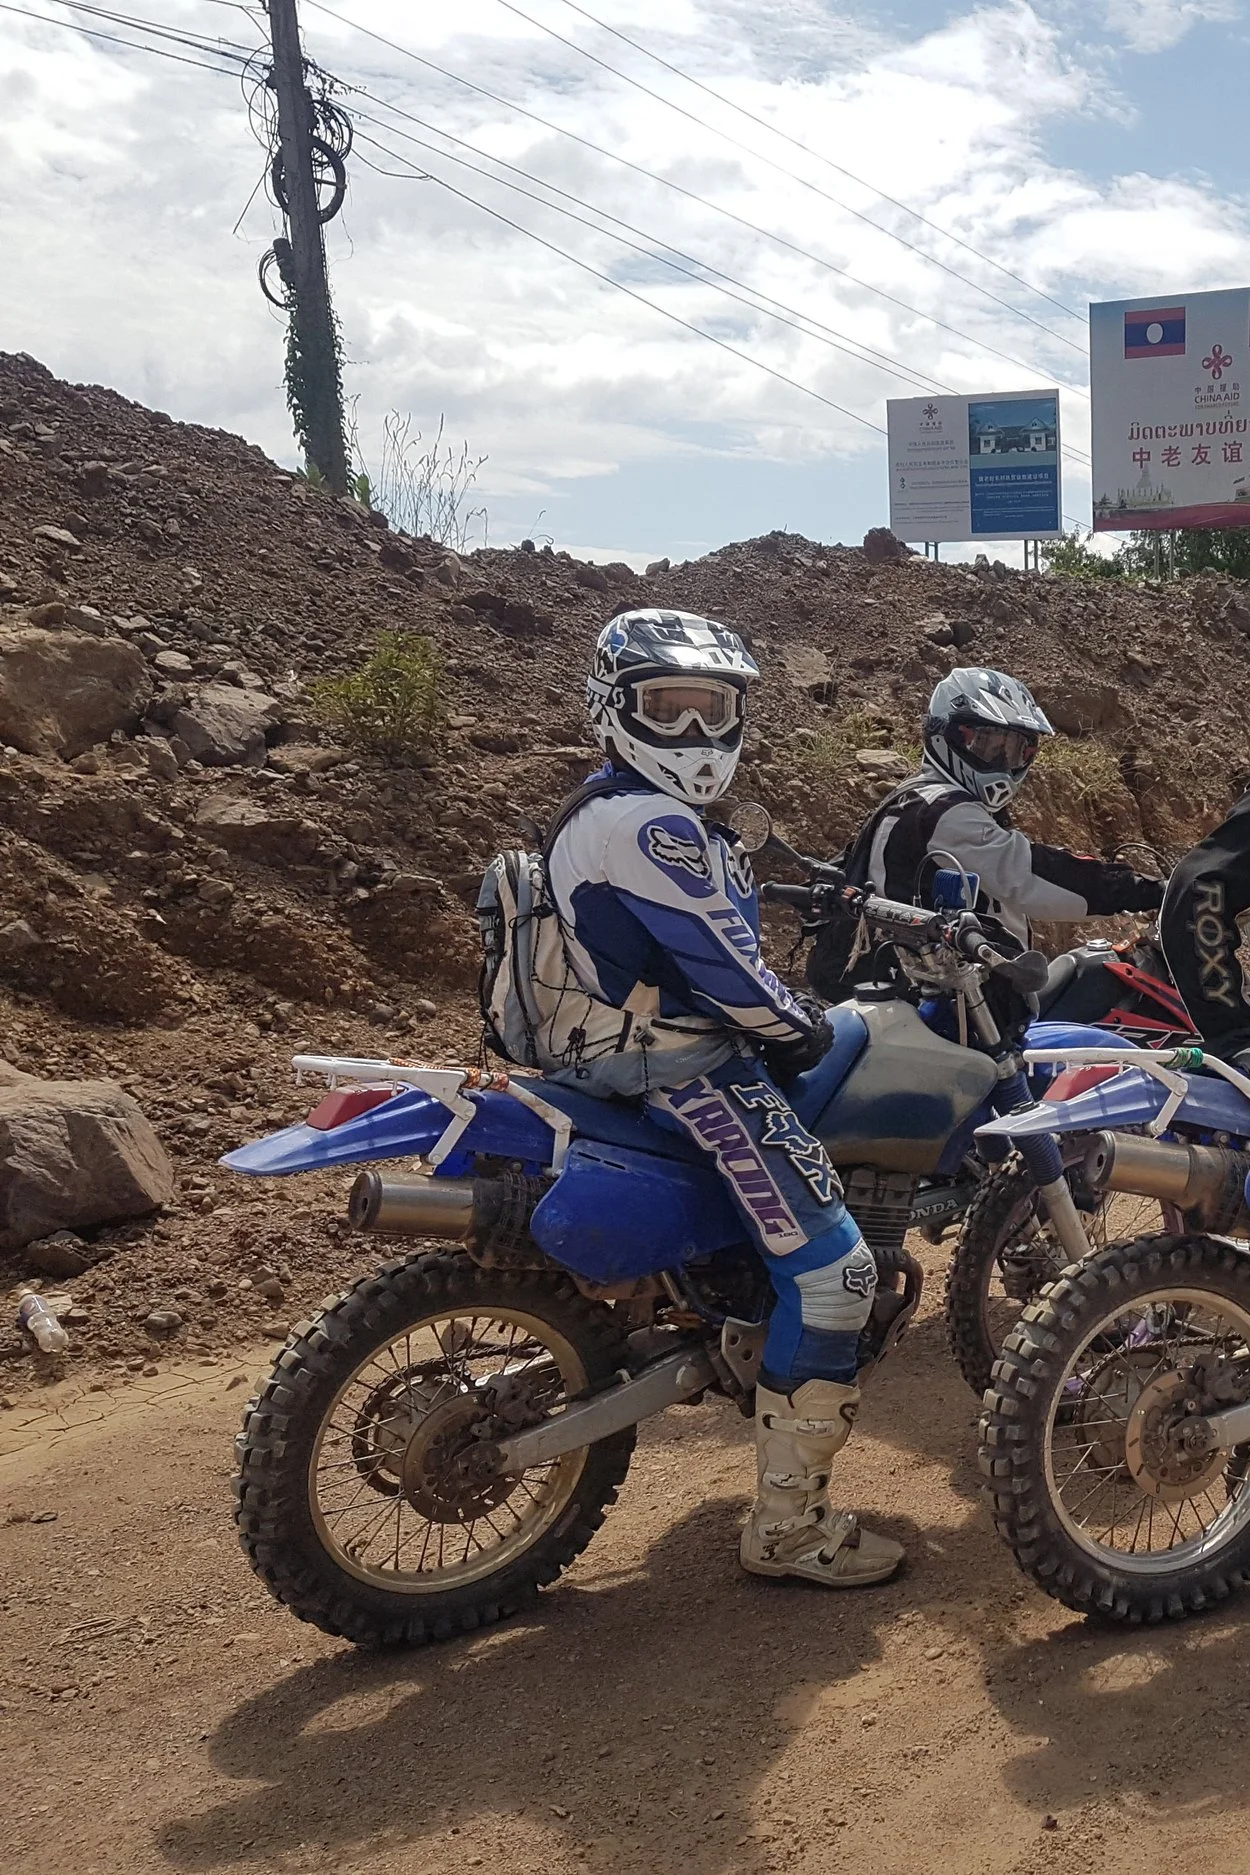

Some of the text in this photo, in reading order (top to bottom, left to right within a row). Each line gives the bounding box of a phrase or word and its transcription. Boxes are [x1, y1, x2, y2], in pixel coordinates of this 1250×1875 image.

[1194, 392, 1240, 404] CHINA AID
[1189, 878, 1236, 1008] ROXY
[681, 1099, 797, 1236] RACING
